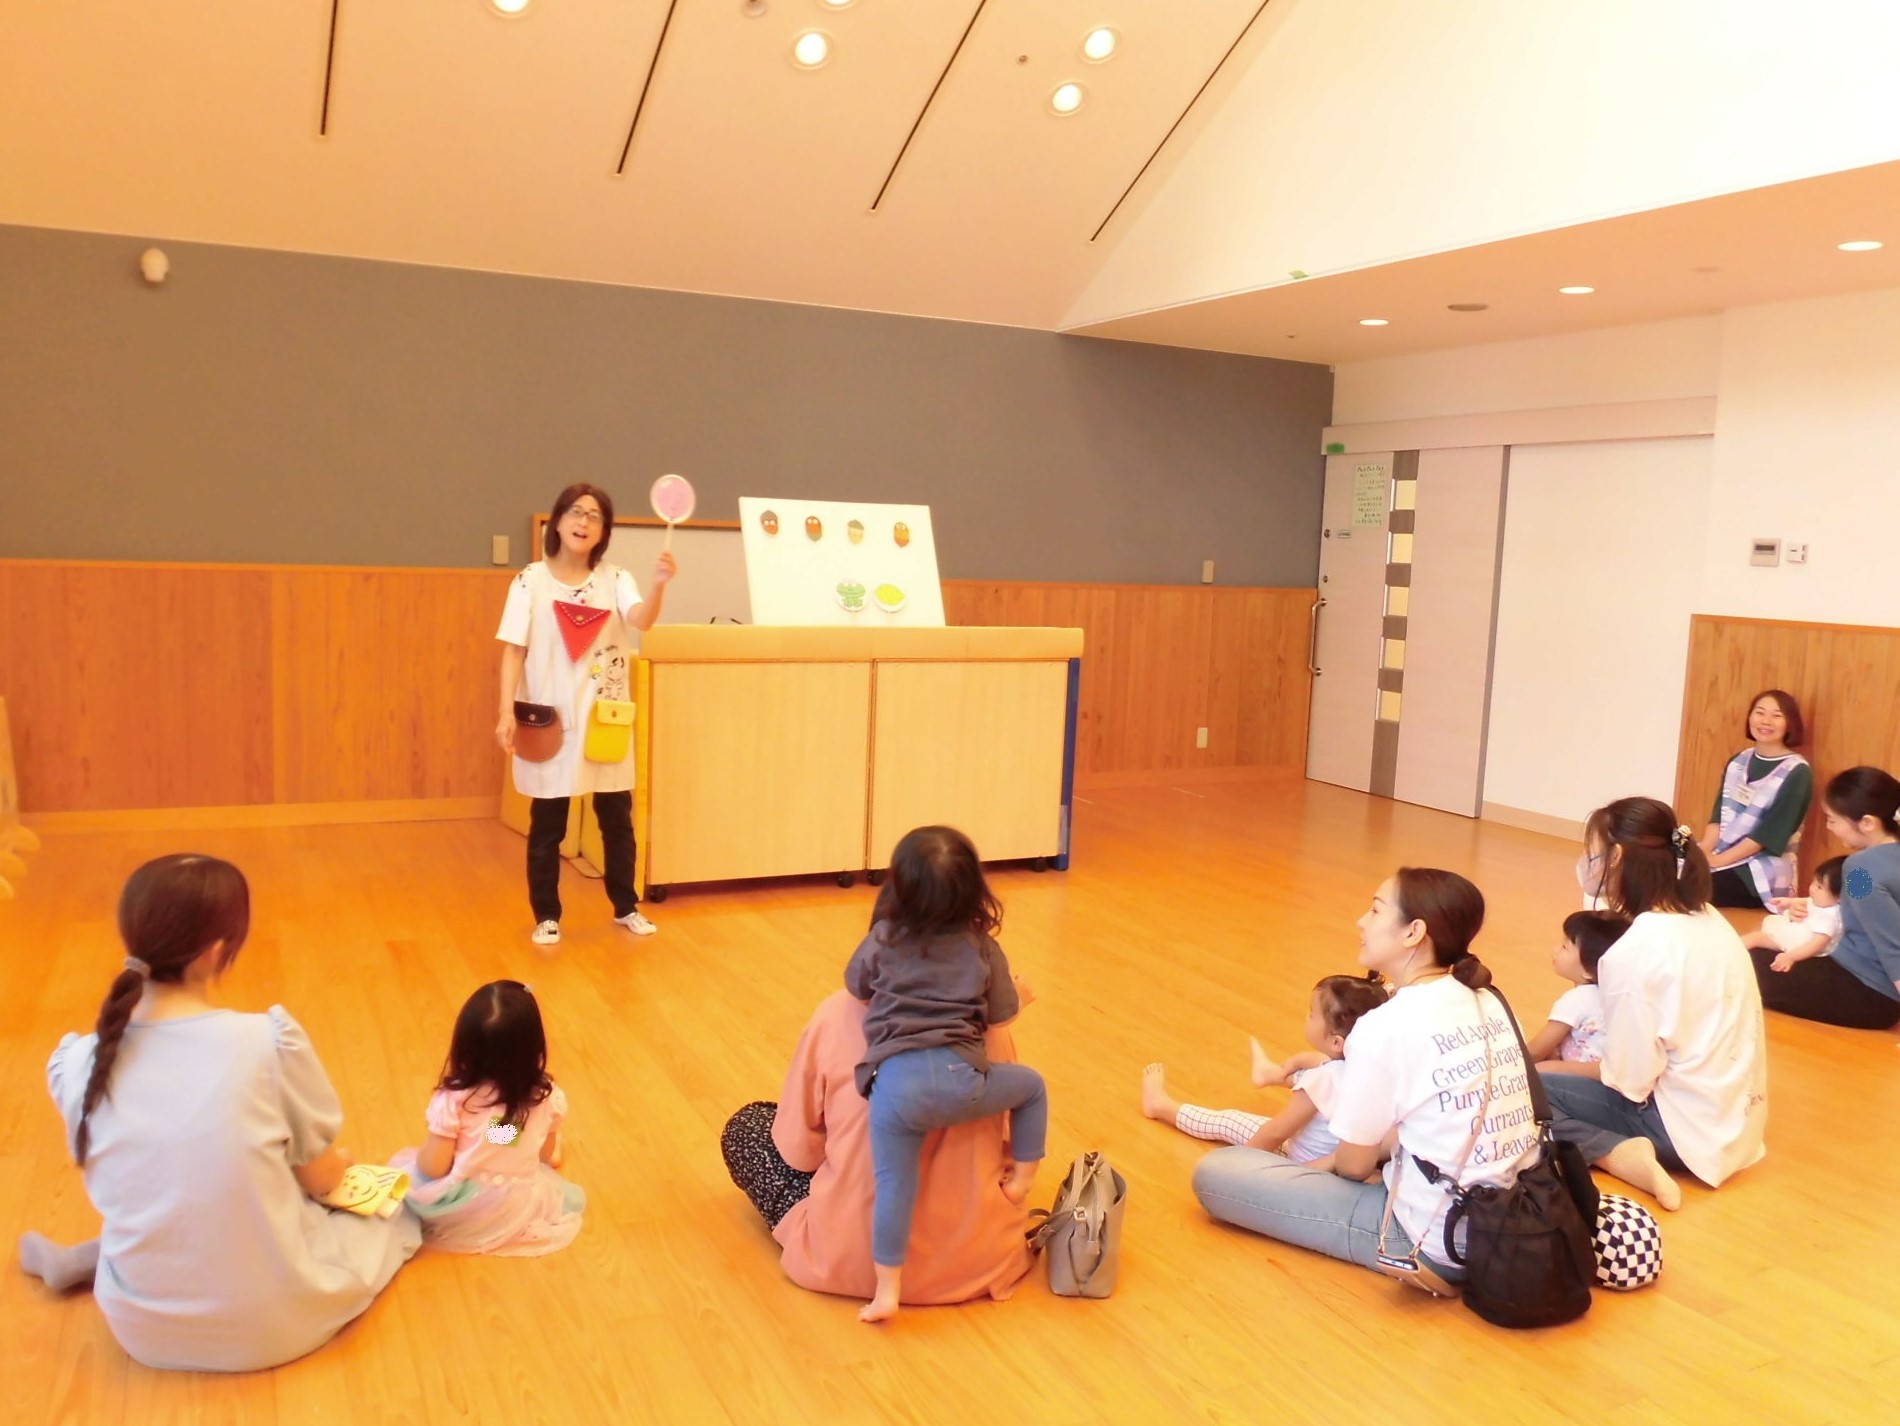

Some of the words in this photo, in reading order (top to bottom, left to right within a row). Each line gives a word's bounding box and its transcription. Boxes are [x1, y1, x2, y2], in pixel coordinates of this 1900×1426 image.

[1432, 1027, 1468, 1055] Red
[1467, 1017, 1510, 1042] Apple,
[1432, 1056, 1488, 1088] Green
[1475, 1144, 1489, 1165] &
[1493, 1133, 1538, 1162] Leaves
